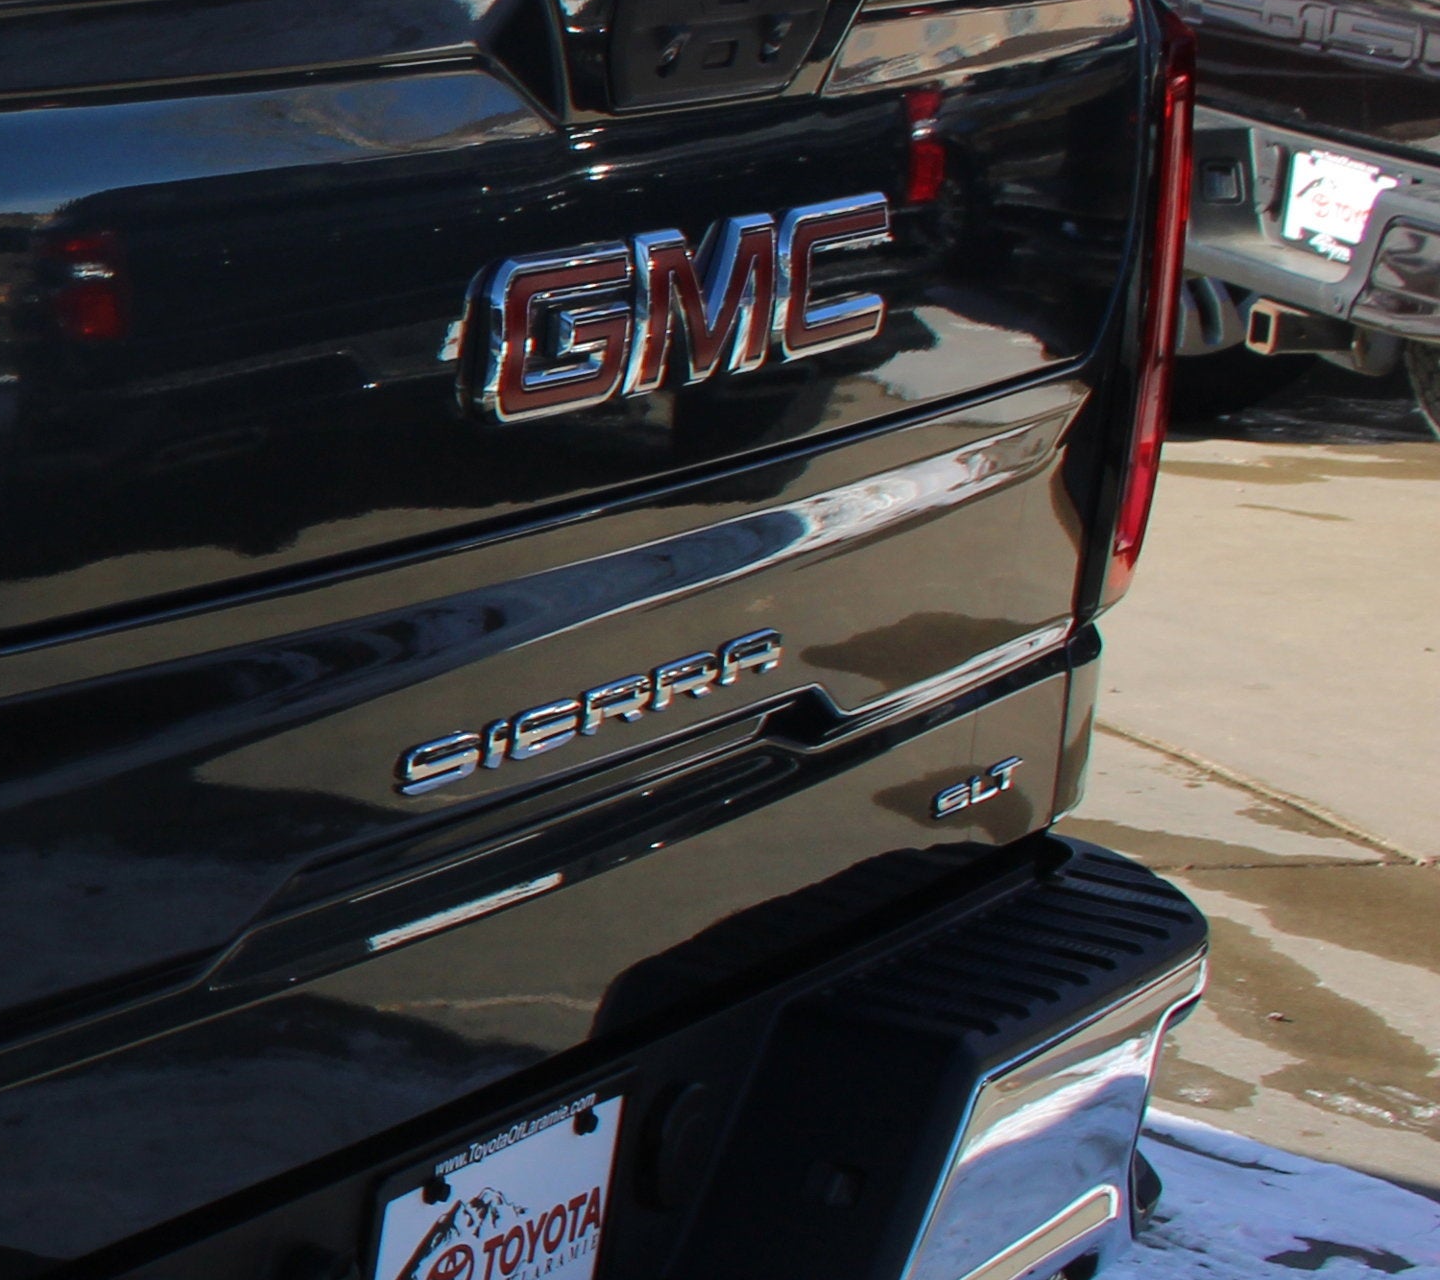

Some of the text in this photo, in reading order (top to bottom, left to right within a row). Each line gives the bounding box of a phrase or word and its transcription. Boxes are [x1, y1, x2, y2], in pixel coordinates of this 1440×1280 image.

[458, 191, 893, 425] GMC
[394, 628, 784, 797] SIERRA
[933, 756, 1023, 820] SLT
